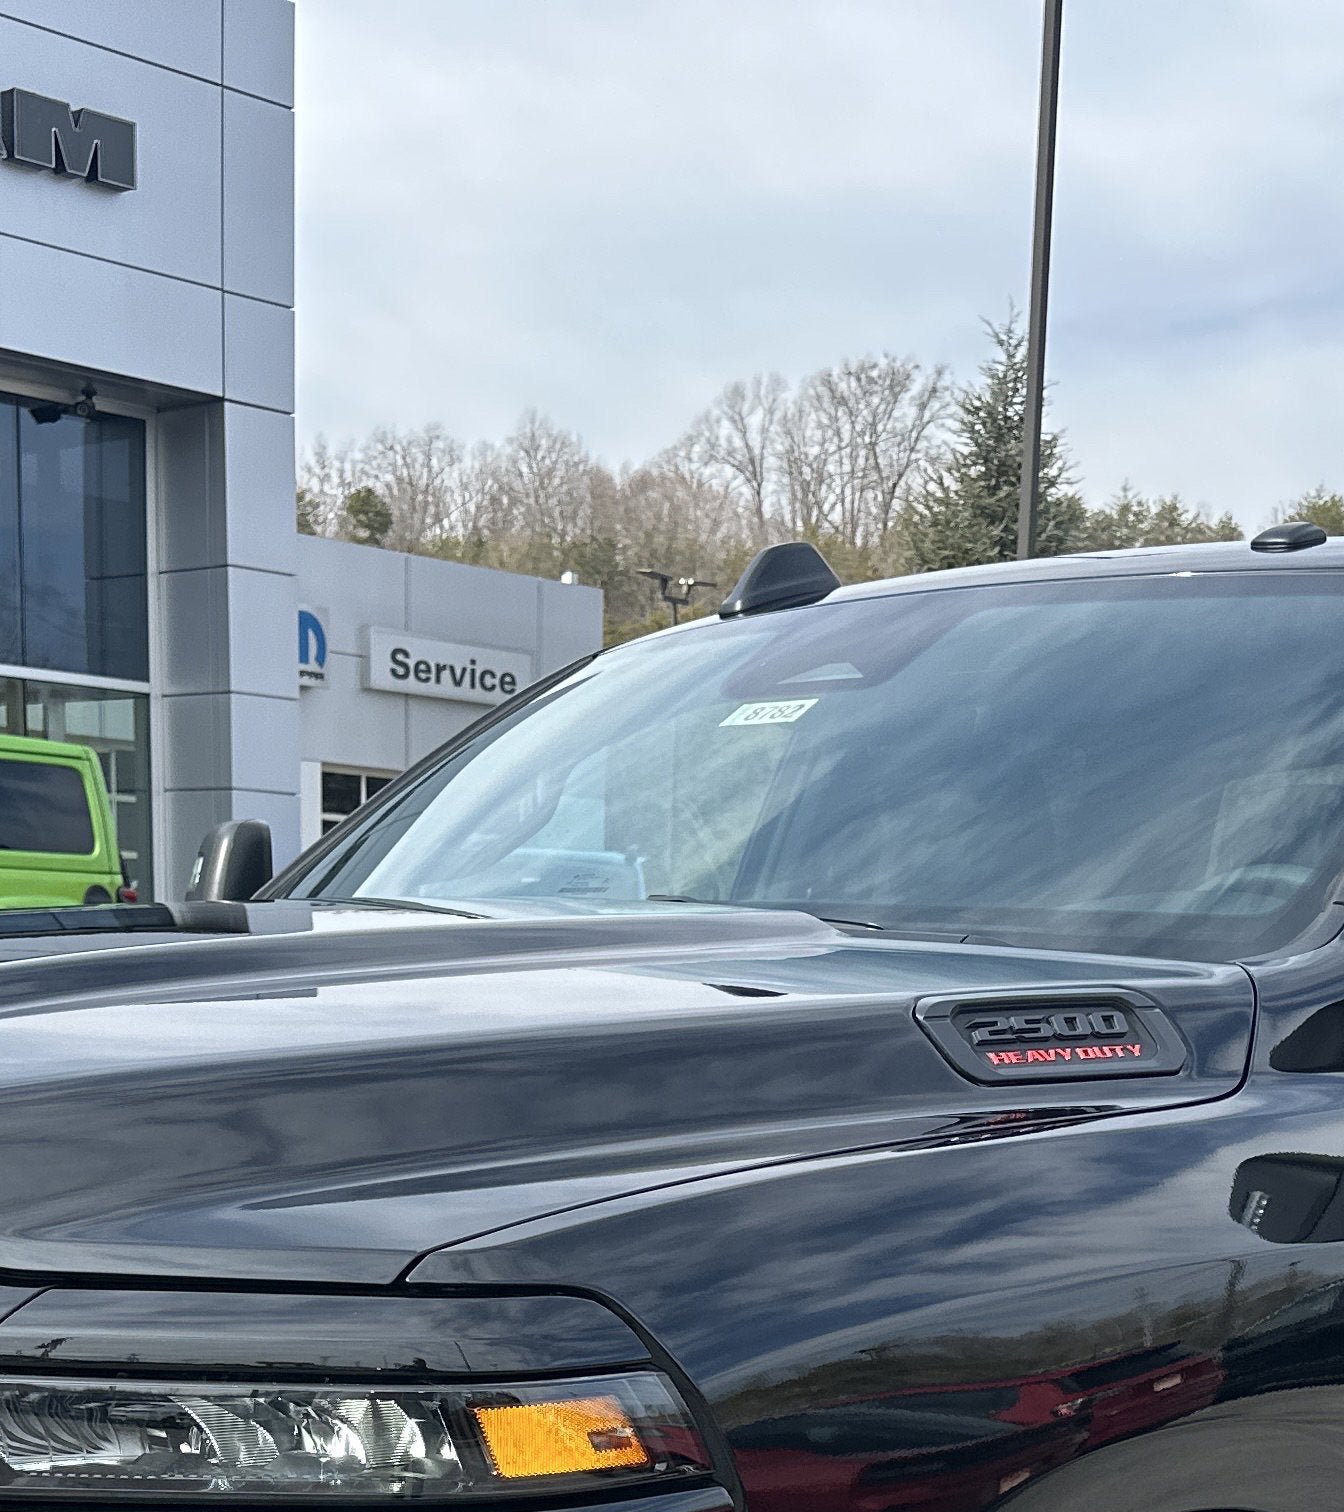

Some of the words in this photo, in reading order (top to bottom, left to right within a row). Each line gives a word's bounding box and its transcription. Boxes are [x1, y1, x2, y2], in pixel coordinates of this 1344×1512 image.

[390, 648, 518, 695] Service
[965, 1011, 1129, 1046] 2500
[986, 1048, 1071, 1065] HEAVY
[1075, 1044, 1141, 1060] DUTY
